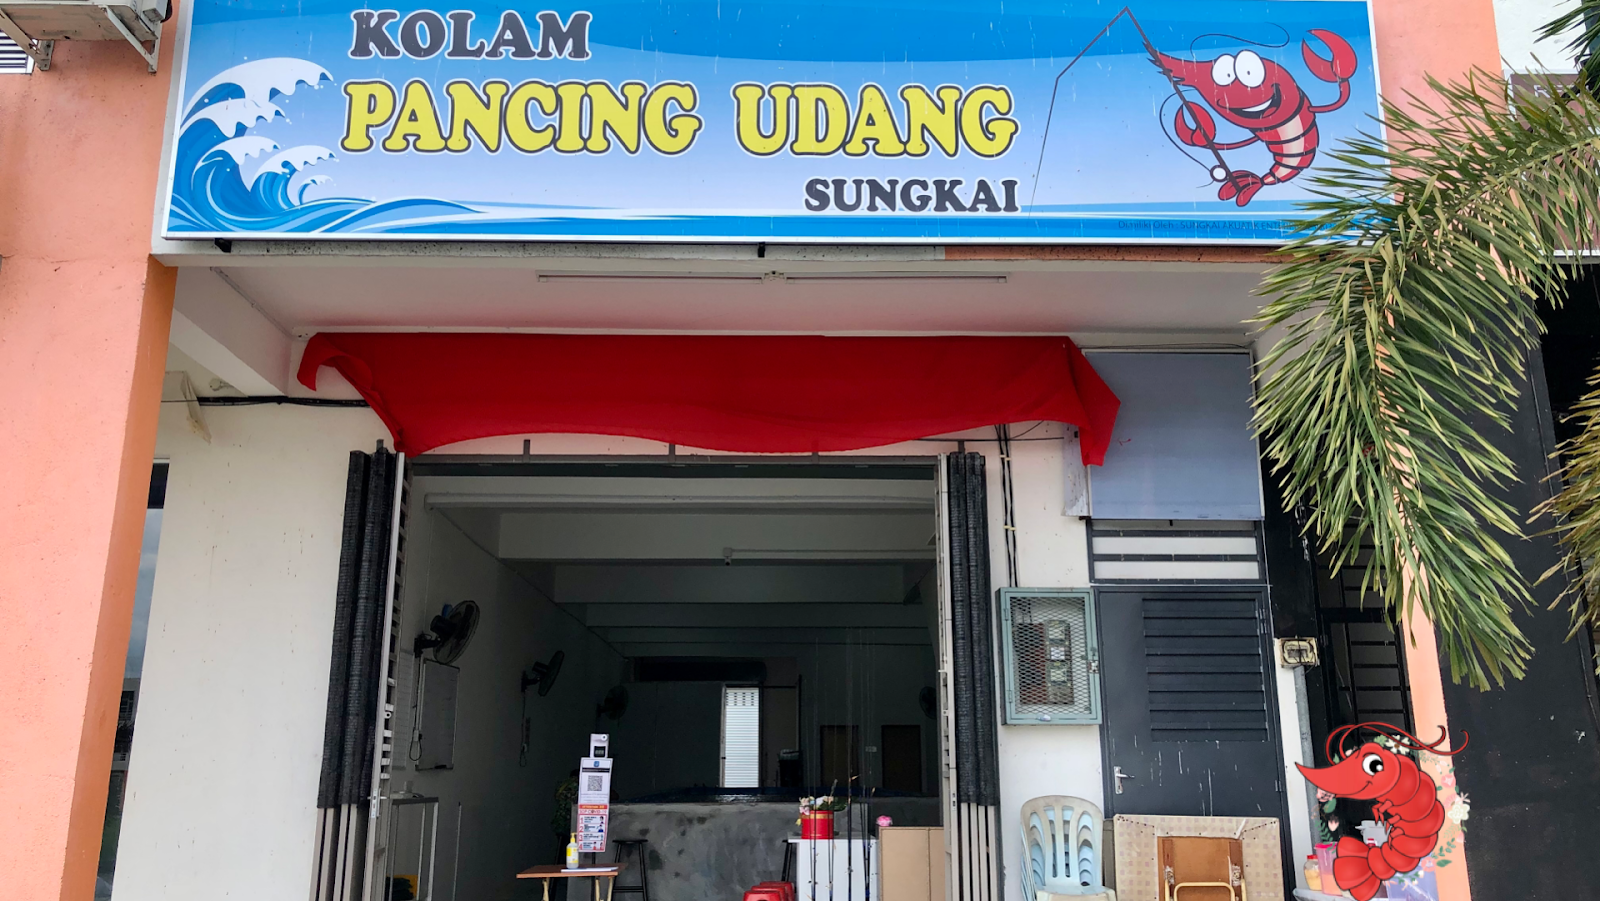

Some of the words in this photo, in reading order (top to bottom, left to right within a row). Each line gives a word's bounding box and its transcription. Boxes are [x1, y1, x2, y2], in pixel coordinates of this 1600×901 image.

[351, 11, 591, 59] KOLAM
[341, 80, 702, 155] PANCING
[733, 83, 1019, 158] UDANG
[805, 178, 1019, 212] SUNGKAI
[1153, 220, 1173, 230] Oleh
[1180, 220, 1220, 230] SUNGKAI
[1222, 220, 1260, 230] AKUATIK
